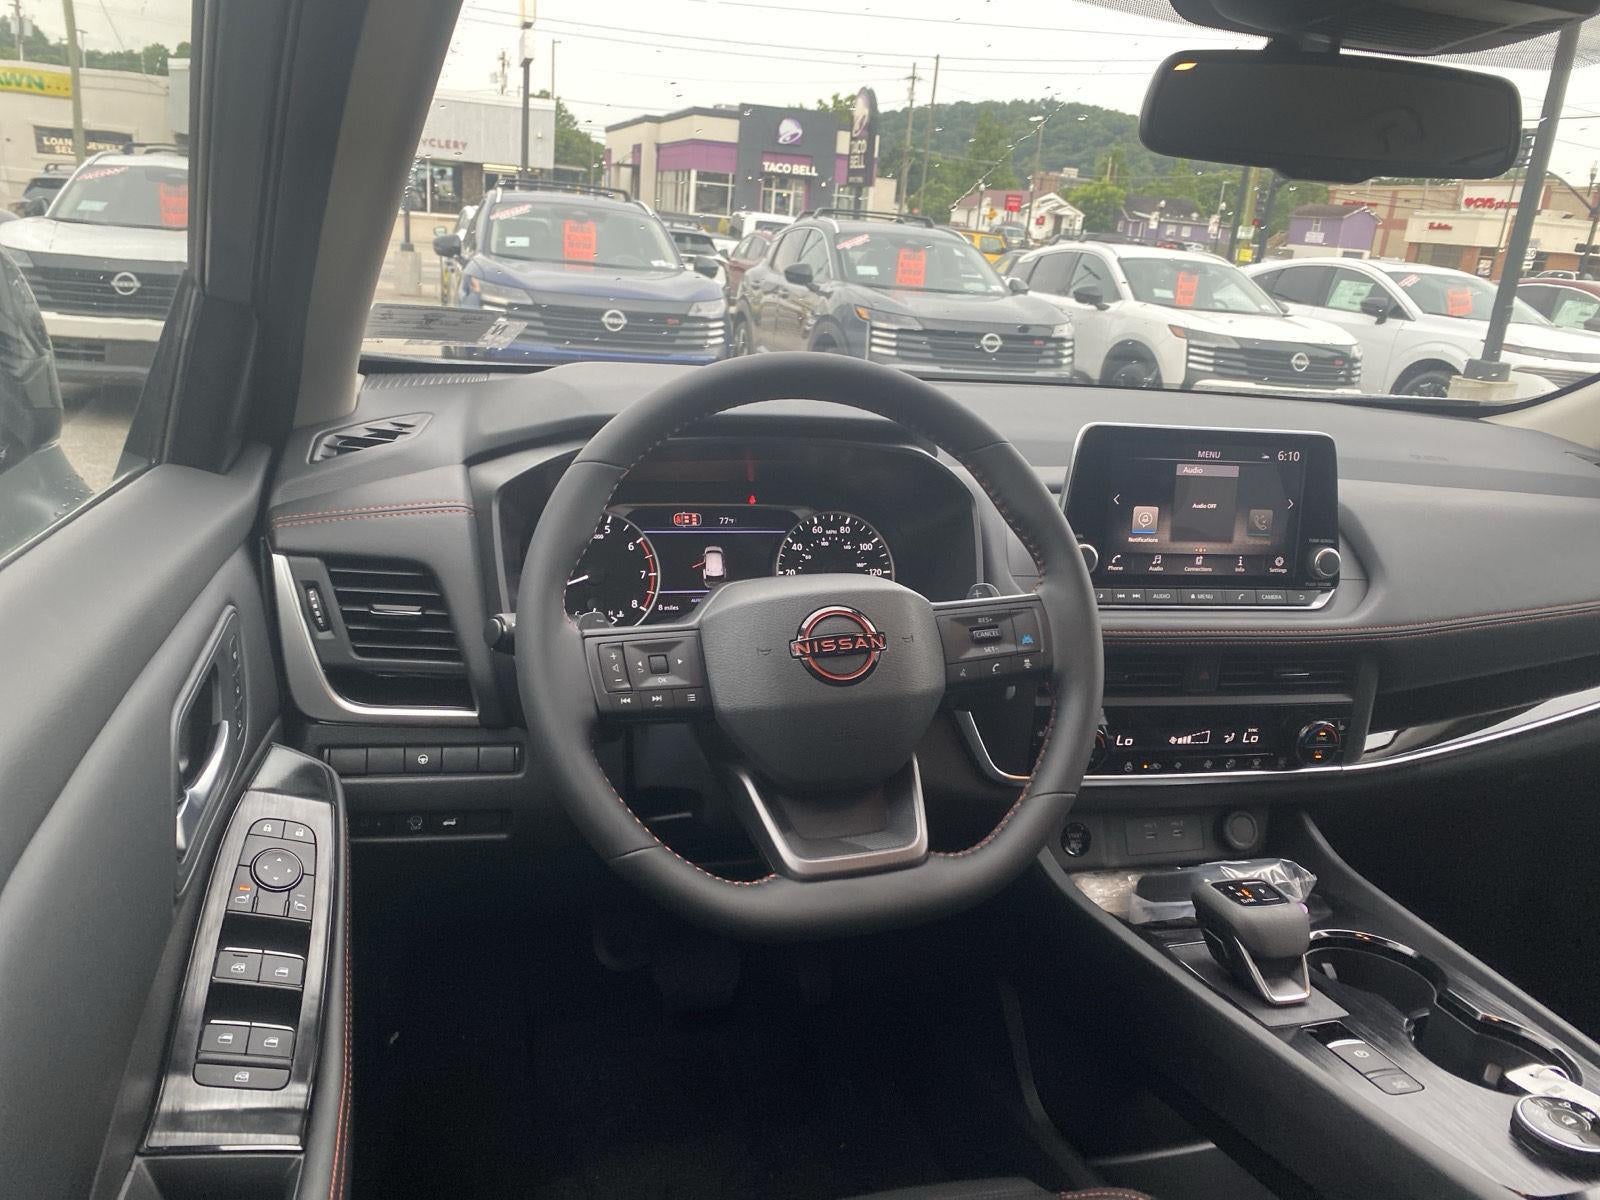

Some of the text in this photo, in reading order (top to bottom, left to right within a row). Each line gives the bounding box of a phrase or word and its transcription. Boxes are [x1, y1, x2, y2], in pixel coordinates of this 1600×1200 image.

[763, 162, 818, 176] TACO BELL
[1198, 451, 1220, 459] MENU
[1278, 451, 1300, 461] 6:10
[604, 525, 611, 534] 5
[812, 526, 823, 534] 60
[840, 526, 851, 534] 80
[628, 542, 635, 551] 6
[792, 543, 803, 551] 40
[860, 543, 873, 551] 100
[640, 571, 646, 580] 7
[631, 600, 638, 608] 8
[976, 630, 1000, 638] CANCEL
[794, 637, 884, 655] NISSAN
[1116, 735, 1133, 746] Lo
[1242, 732, 1259, 743] Lo
